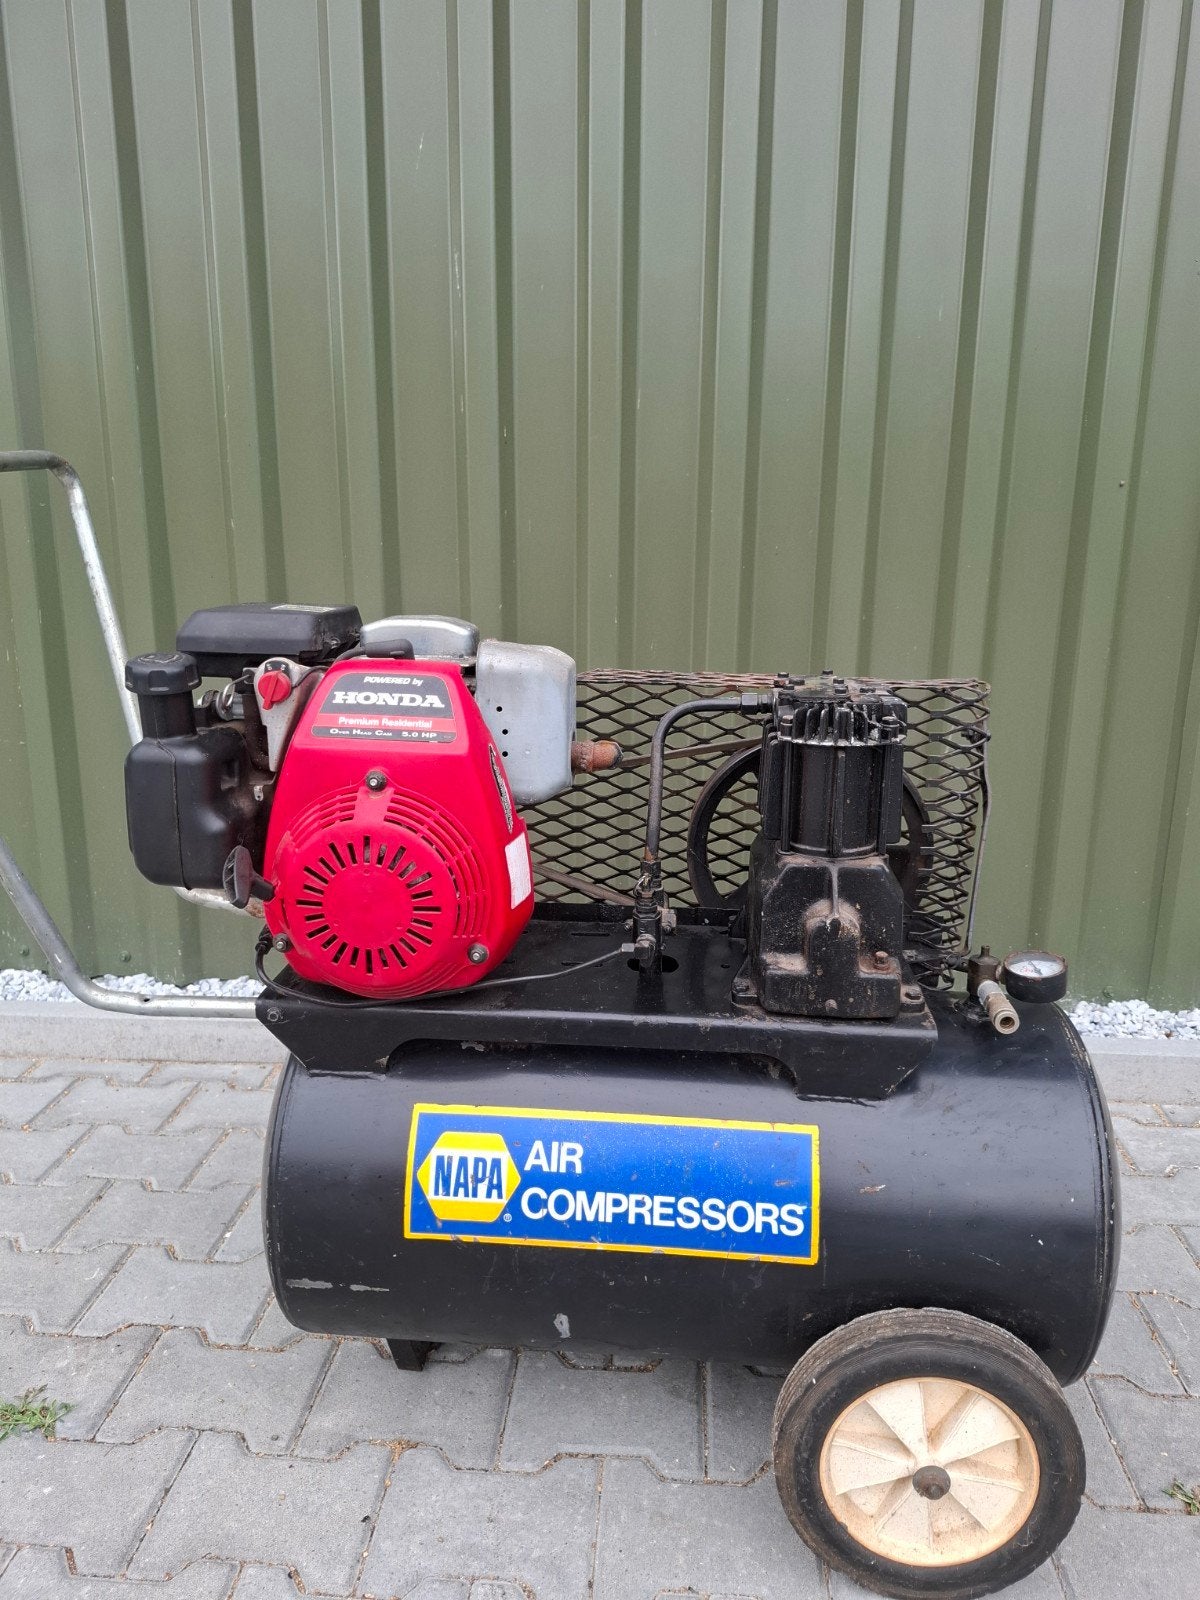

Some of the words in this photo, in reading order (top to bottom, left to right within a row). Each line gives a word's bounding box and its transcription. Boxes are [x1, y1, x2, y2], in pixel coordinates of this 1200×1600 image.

[363, 676, 411, 685] POWERED
[412, 677, 424, 687] by
[332, 691, 445, 708] HONDA
[338, 716, 380, 727] Premium
[382, 718, 433, 729] Residential
[524, 1141, 583, 1173] AIR
[434, 1155, 504, 1199] NAPA
[520, 1188, 805, 1236] COMPRESSORS
